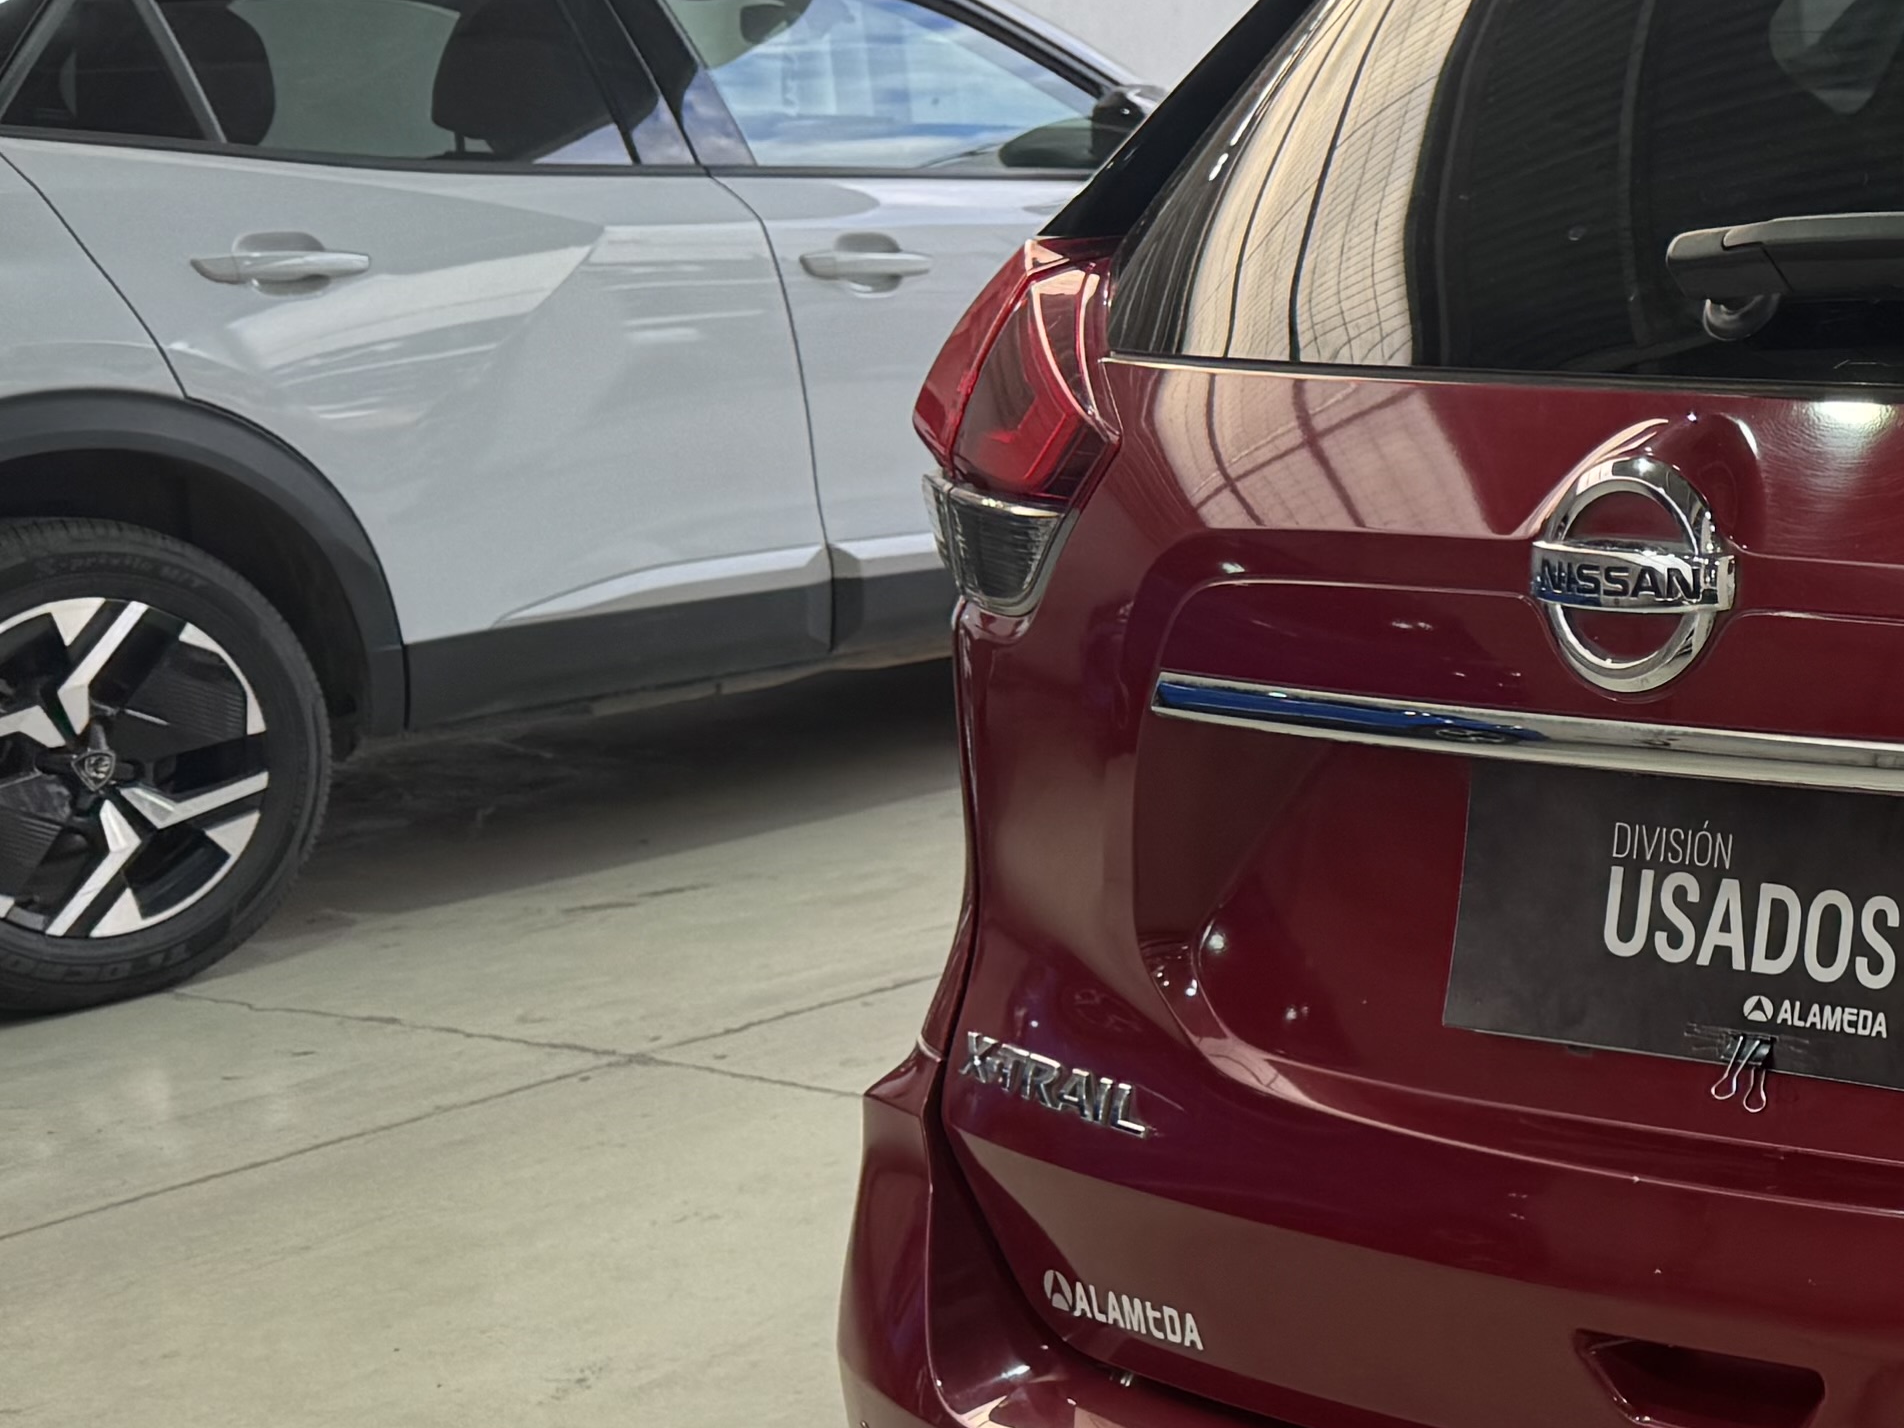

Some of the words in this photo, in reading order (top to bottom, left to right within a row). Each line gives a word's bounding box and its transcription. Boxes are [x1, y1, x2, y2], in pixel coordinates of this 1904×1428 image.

[1541, 558, 1701, 603] NISSAN
[1612, 820, 1734, 869] DIVISIÓN
[1603, 865, 1900, 990] USADOS
[1776, 998, 1888, 1039] ALAMEDA
[958, 1031, 1150, 1139] X-TRAIL
[1073, 1280, 1204, 1351] ALAMEDA
